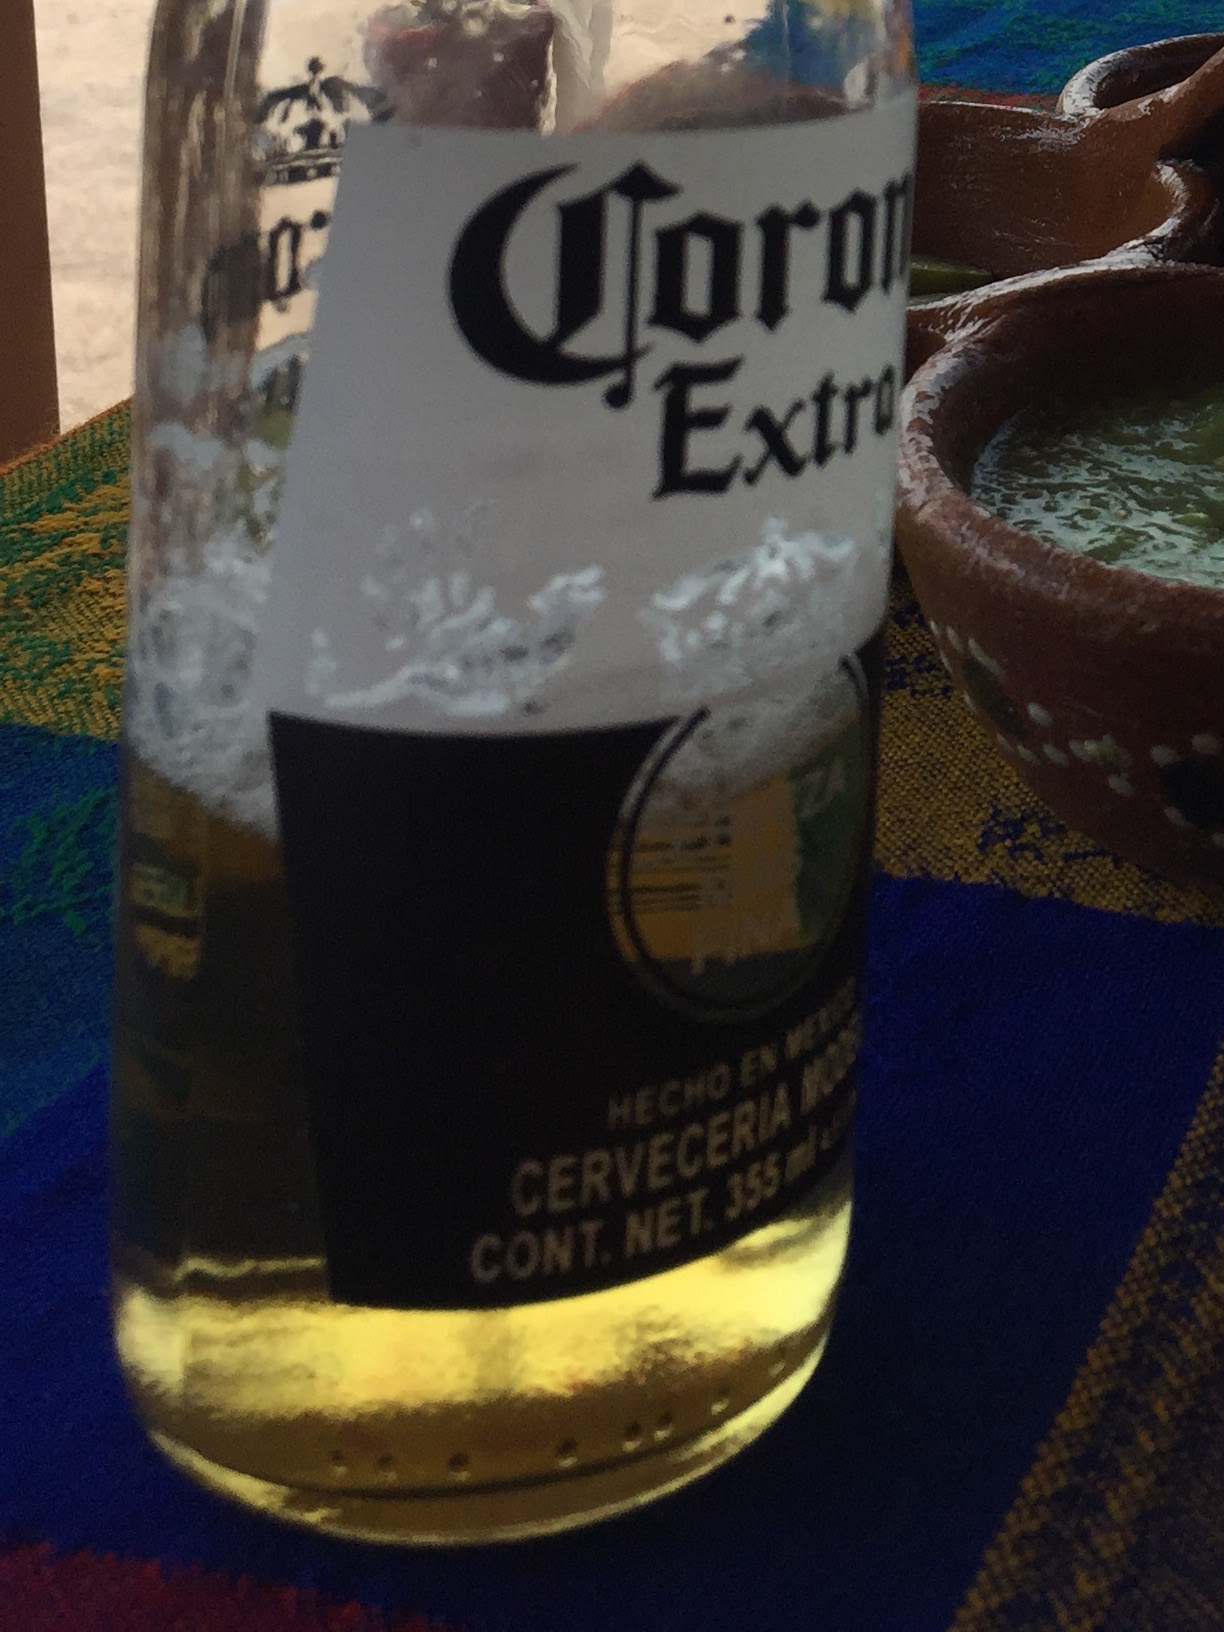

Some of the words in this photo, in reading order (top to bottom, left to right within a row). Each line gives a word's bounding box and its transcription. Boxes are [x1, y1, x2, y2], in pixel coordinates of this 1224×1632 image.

[510, 1082, 792, 1216] CERVECERIA
[607, 1063, 732, 1131] HECHO
[741, 1043, 779, 1088] EN
[470, 1218, 612, 1284] CONT.
[625, 1188, 715, 1258] NET.
[724, 1151, 785, 1220] 355
